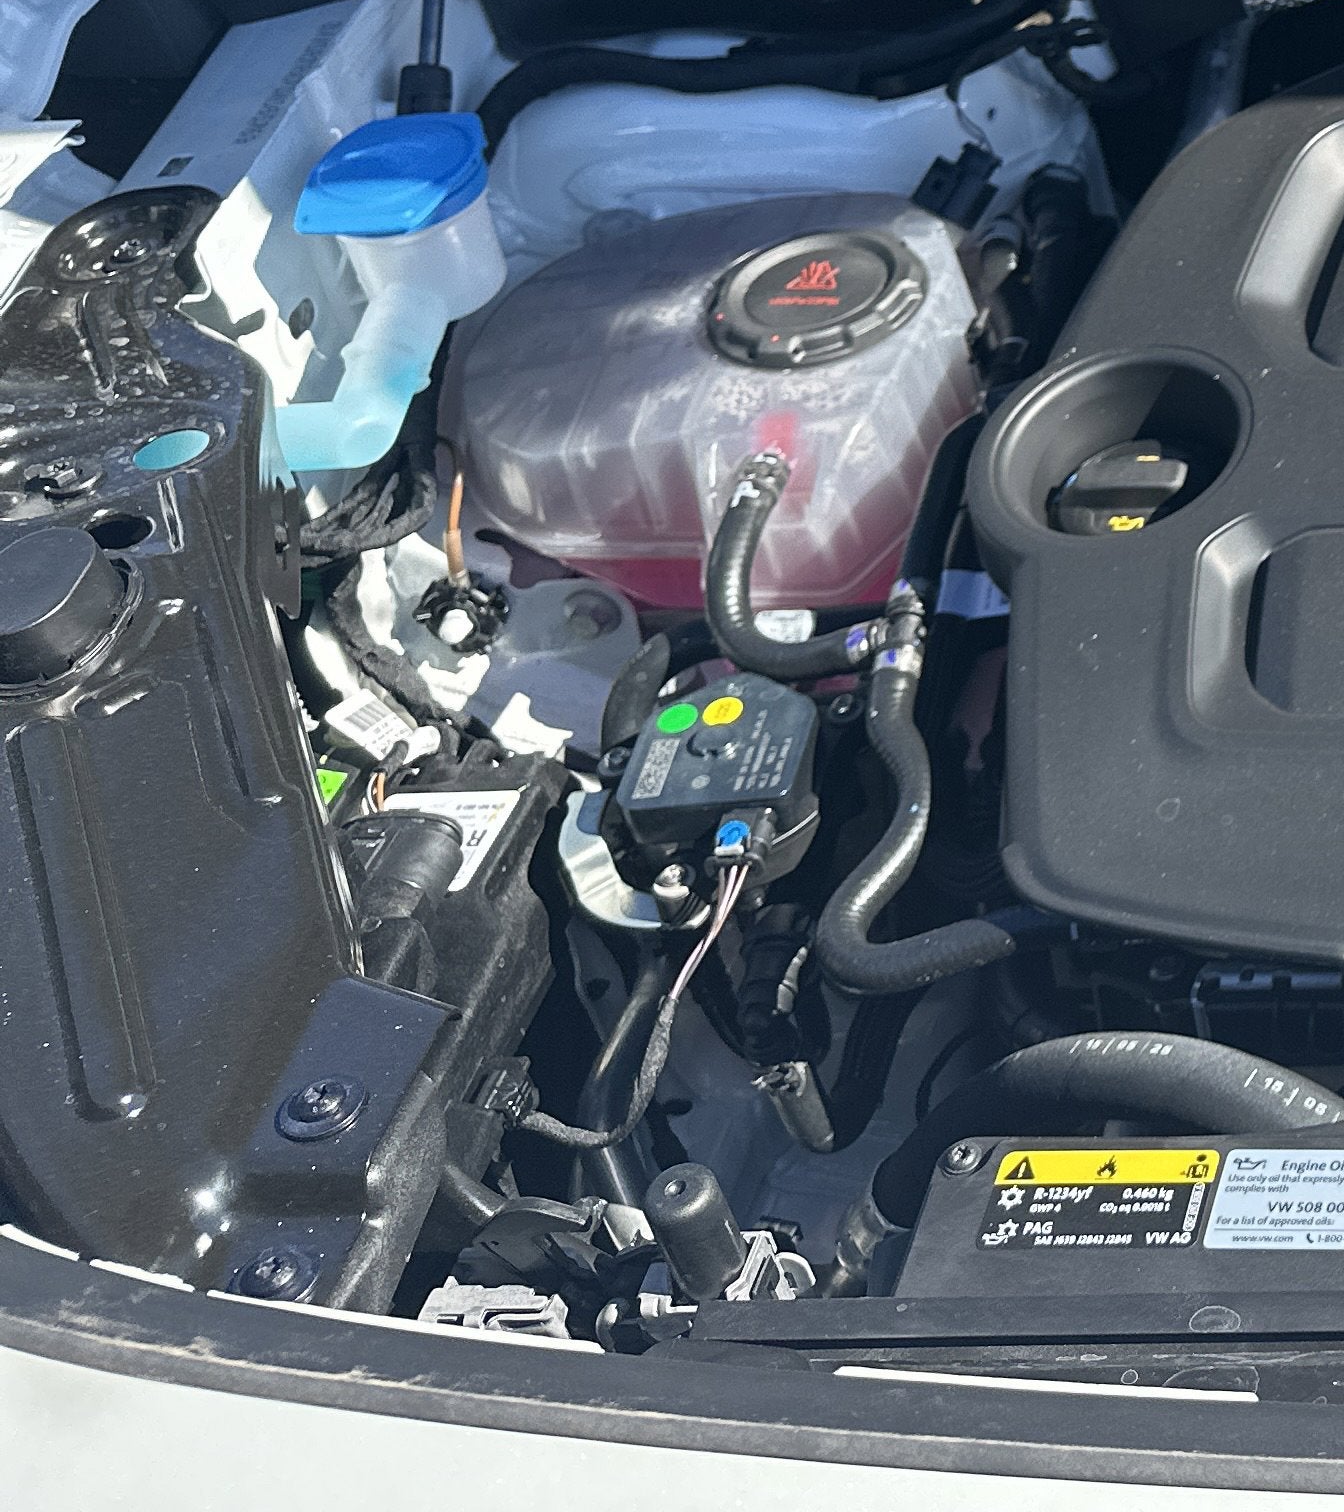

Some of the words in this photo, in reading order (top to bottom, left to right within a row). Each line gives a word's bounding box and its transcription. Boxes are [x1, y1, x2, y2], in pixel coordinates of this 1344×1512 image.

[1281, 1159, 1326, 1174] Engine
[1227, 1174, 1245, 1183] Use
[1246, 1174, 1267, 1185] only
[1268, 1174, 1280, 1183] oil
[1281, 1174, 1301, 1183] that
[1158, 1187, 1174, 1201] kg
[1224, 1185, 1266, 1195] complies
[1267, 1185, 1289, 1193] with
[1268, 1201, 1294, 1213] VW
[1295, 1201, 1323, 1213] 508
[1022, 1221, 1054, 1235] PAG
[1216, 1216, 1231, 1226] For
[1232, 1218, 1239, 1226] a
[1240, 1216, 1254, 1226] list
[1257, 1216, 1269, 1226] of
[1273, 1217, 1314, 1228] approved
[1145, 1231, 1169, 1245] VW
[1170, 1231, 1192, 1245] AG
[1232, 1235, 1294, 1243] www.vw.com
